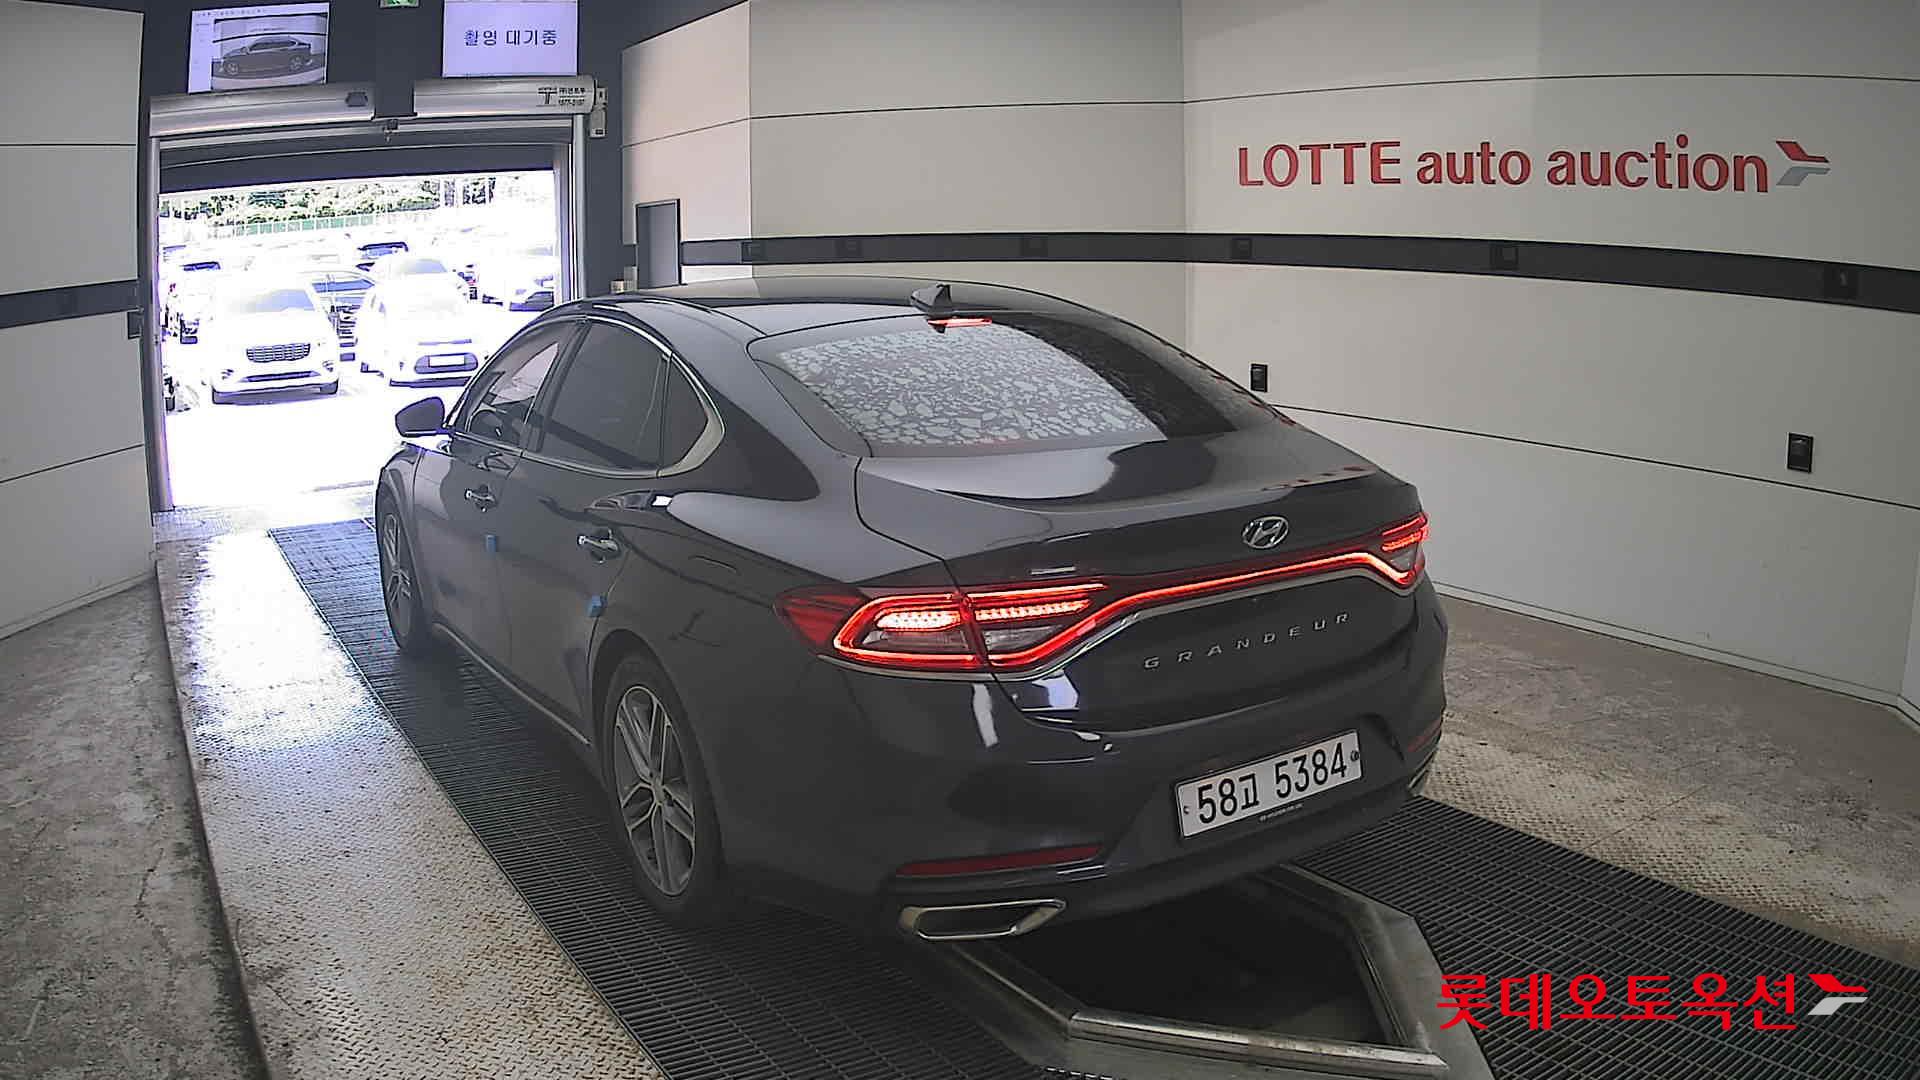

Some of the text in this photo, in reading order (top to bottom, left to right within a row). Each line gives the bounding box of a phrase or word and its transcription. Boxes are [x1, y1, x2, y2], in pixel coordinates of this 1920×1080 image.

[505, 29, 557, 46] 대기중
[1238, 134, 1769, 193] LOTTE auto auction
[1144, 613, 1349, 669] GRANDEUR
[1197, 742, 1348, 824] 58고 5384
